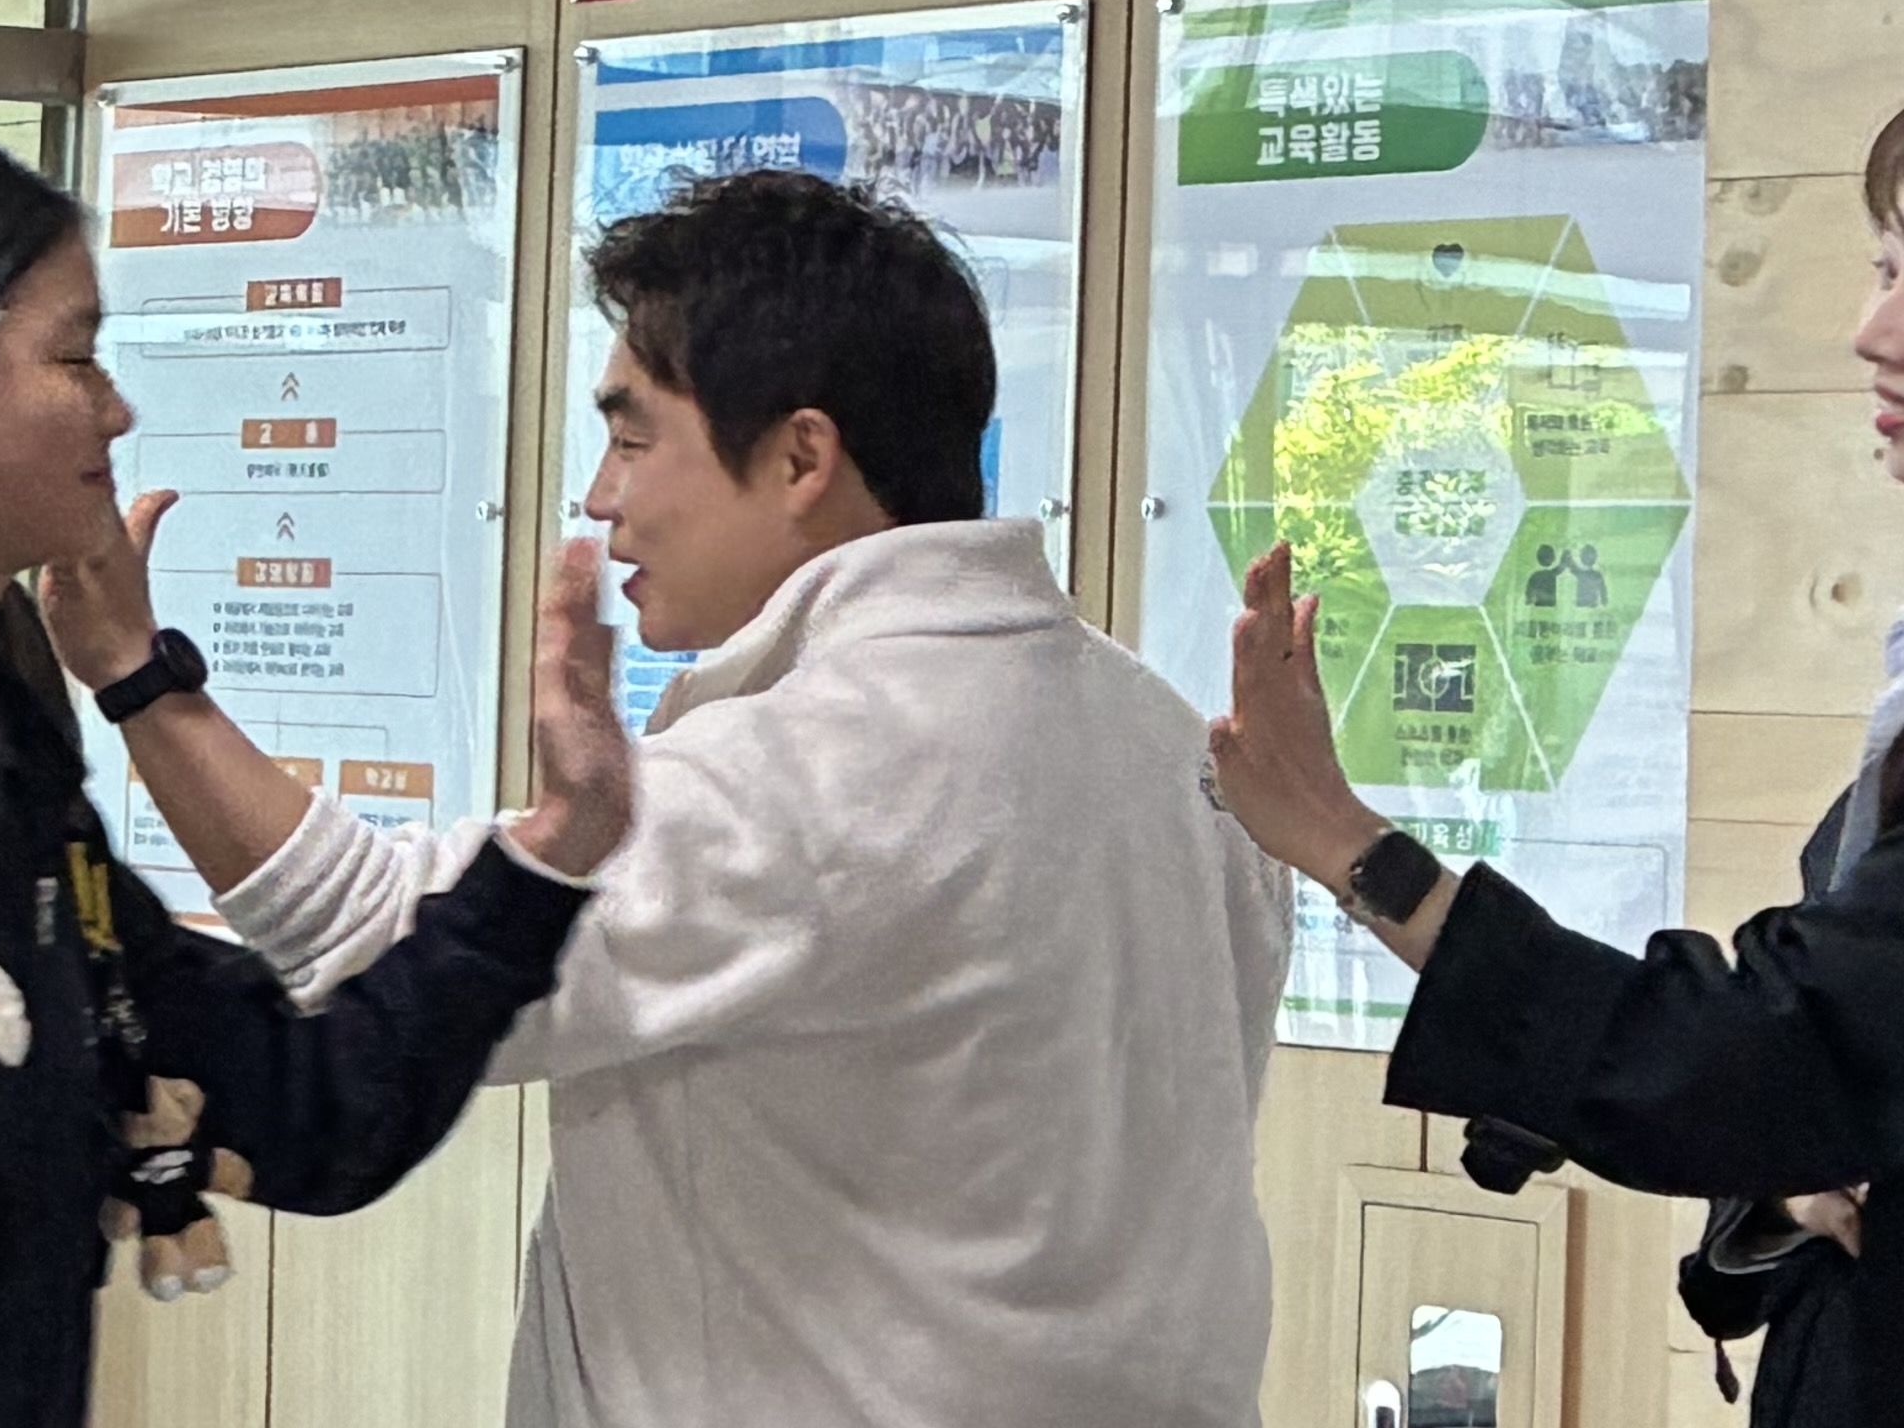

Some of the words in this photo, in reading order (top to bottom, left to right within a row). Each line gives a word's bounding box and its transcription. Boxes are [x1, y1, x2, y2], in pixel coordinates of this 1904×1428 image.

[1258, 73, 1384, 117] 특색있는
[1256, 120, 1382, 166] 교육활동
[151, 161, 193, 194] 학교
[160, 197, 202, 235] 기본
[210, 194, 255, 232] 방향
